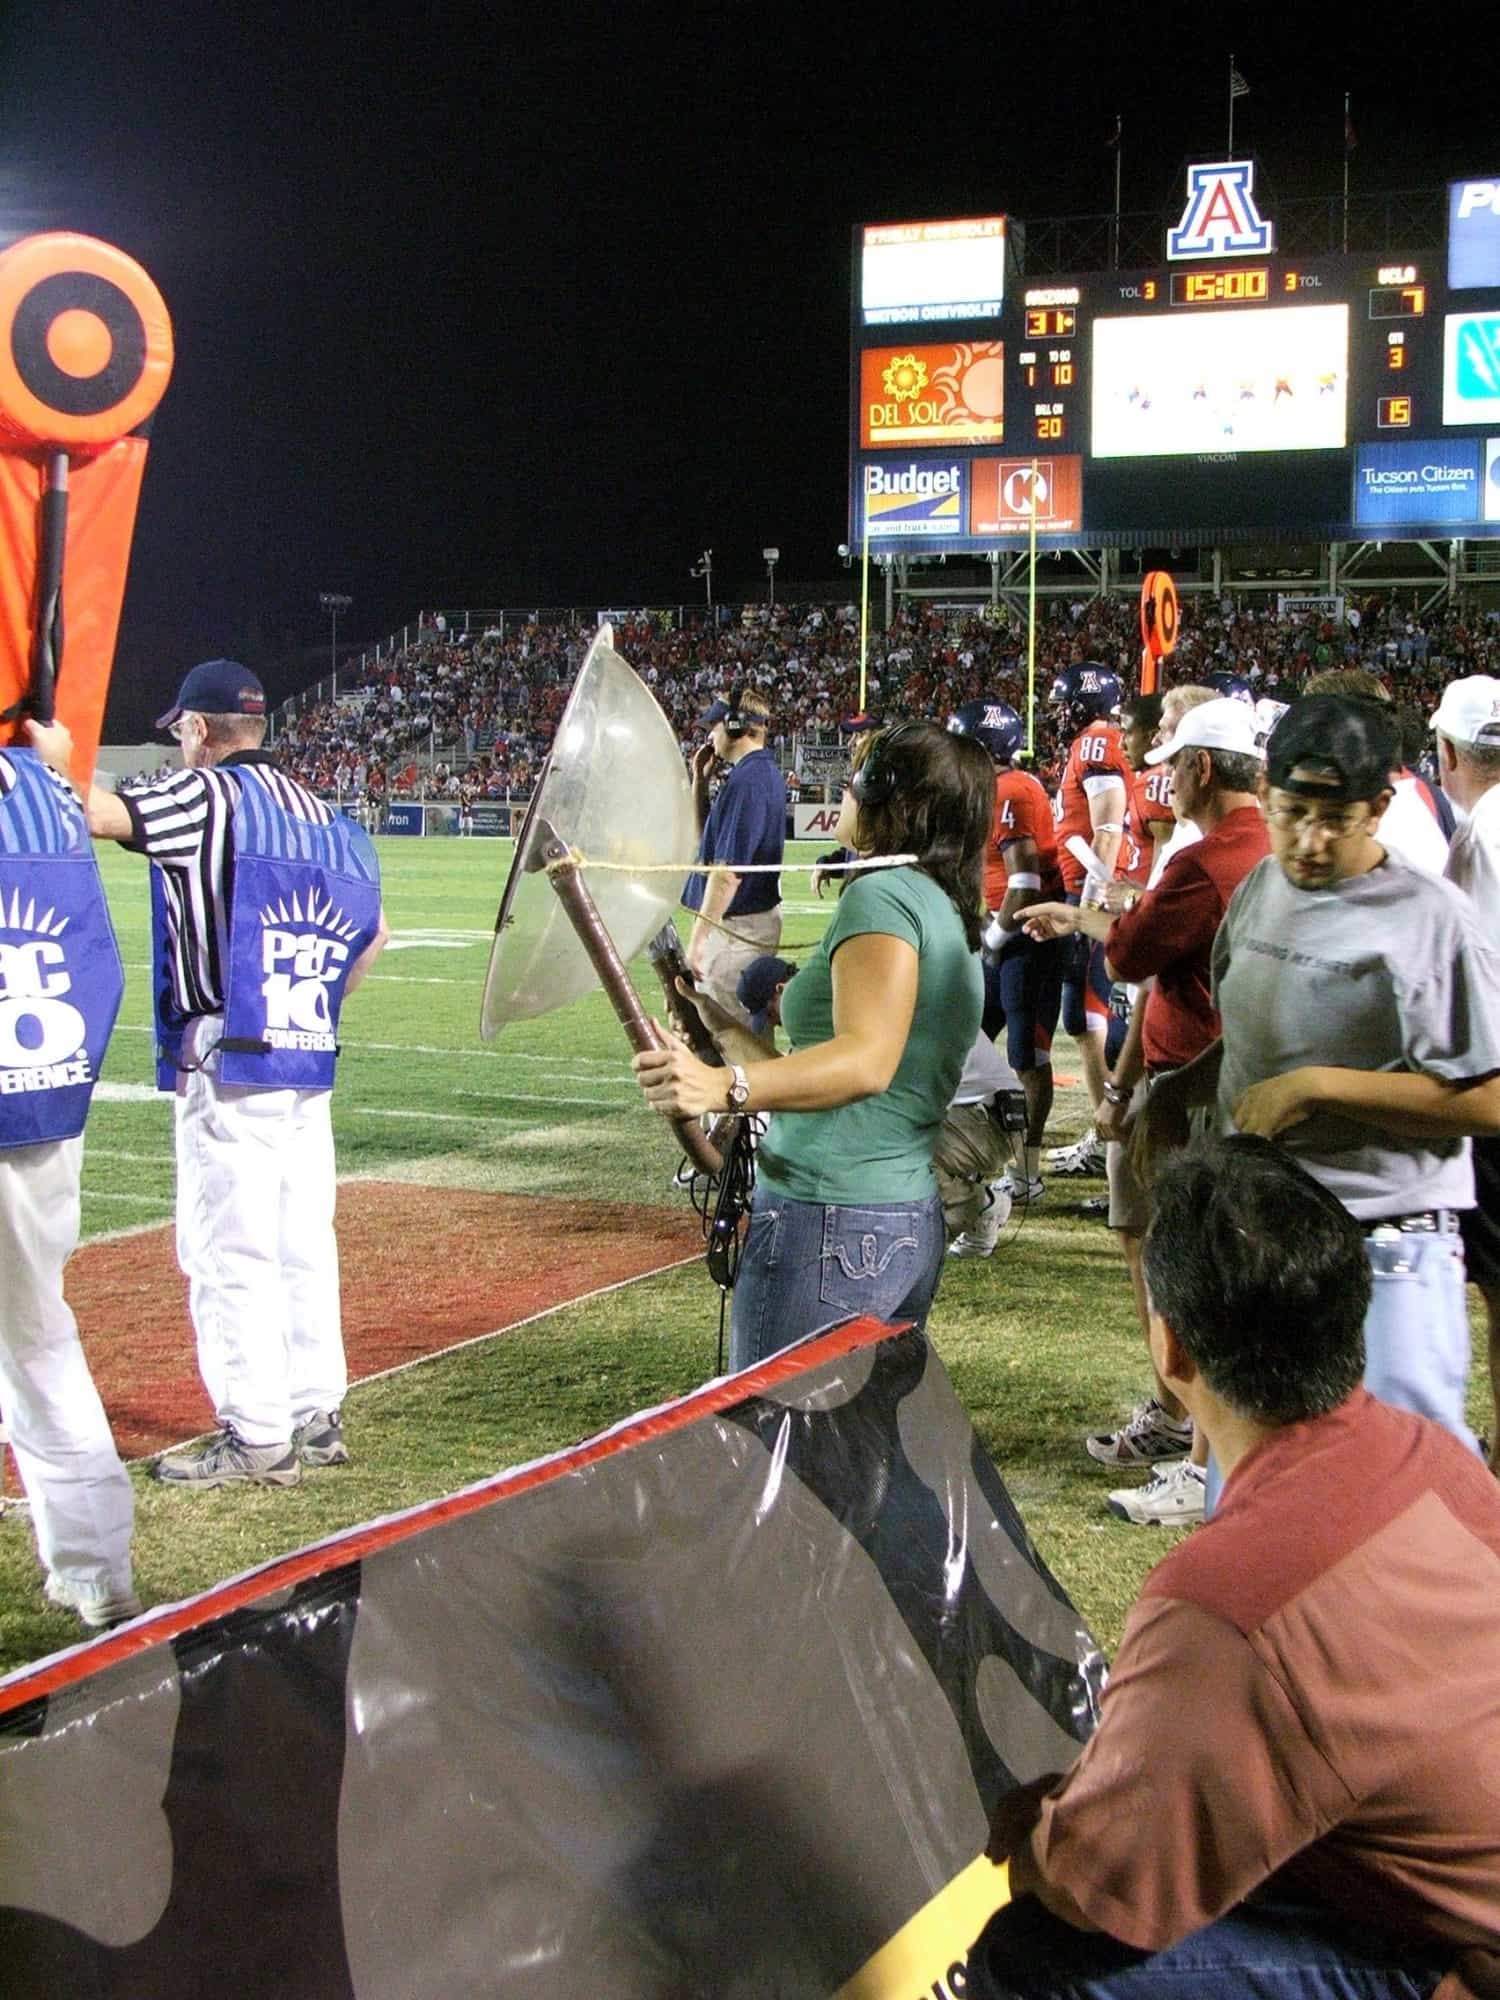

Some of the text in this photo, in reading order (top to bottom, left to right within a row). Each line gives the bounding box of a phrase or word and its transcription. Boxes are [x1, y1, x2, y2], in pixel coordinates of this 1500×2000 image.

[1167, 161, 1272, 260] A
[1120, 281, 1155, 300] TOL 3
[1186, 271, 1267, 301] 15:00
[1285, 273, 1322, 291] 3 TOL
[1402, 289, 1424, 313] 7
[1389, 347, 1403, 367] 3
[1028, 367, 1035, 387] 1
[1054, 365, 1073, 385] 10
[870, 401, 942, 426] DEL SOL
[1037, 418, 1062, 439] 20
[864, 464, 960, 500] Budget
[1362, 465, 1474, 485] Tucson Citizen
[1079, 735, 1107, 762] 86
[261, 973, 333, 1033] 10
[0, 1059, 93, 1095] ERENCE
